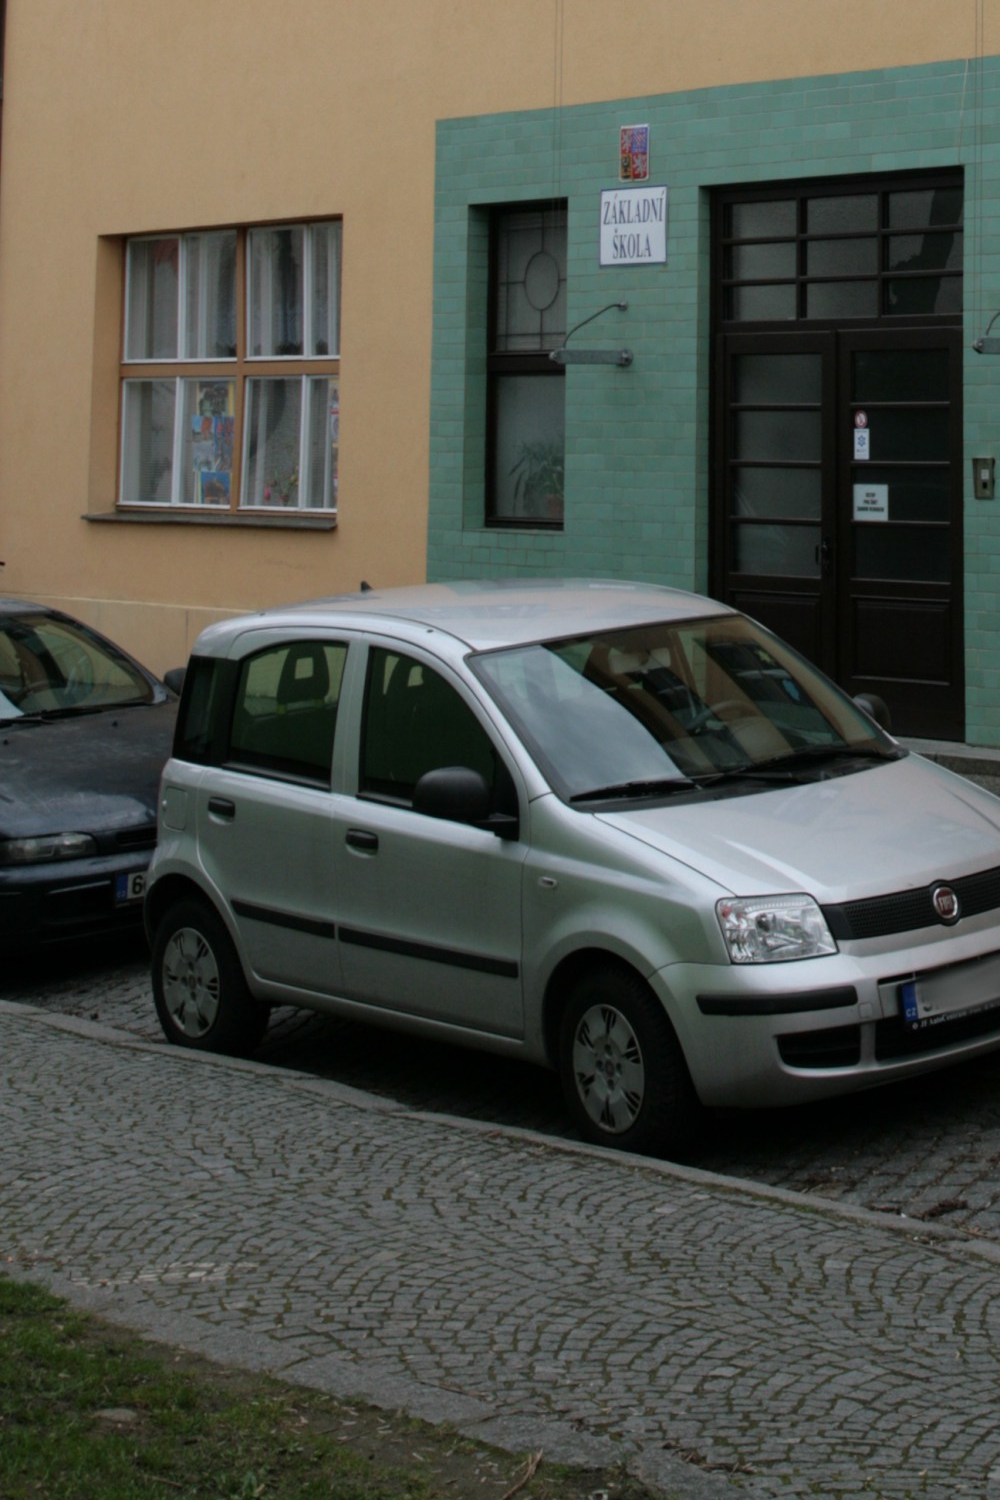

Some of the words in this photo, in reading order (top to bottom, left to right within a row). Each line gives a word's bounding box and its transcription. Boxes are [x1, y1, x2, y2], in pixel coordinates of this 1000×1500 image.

[603, 190, 665, 225] ZÁKLADNÍ
[612, 229, 652, 260] ŠKOLA
[905, 1007, 917, 1018] CZ
